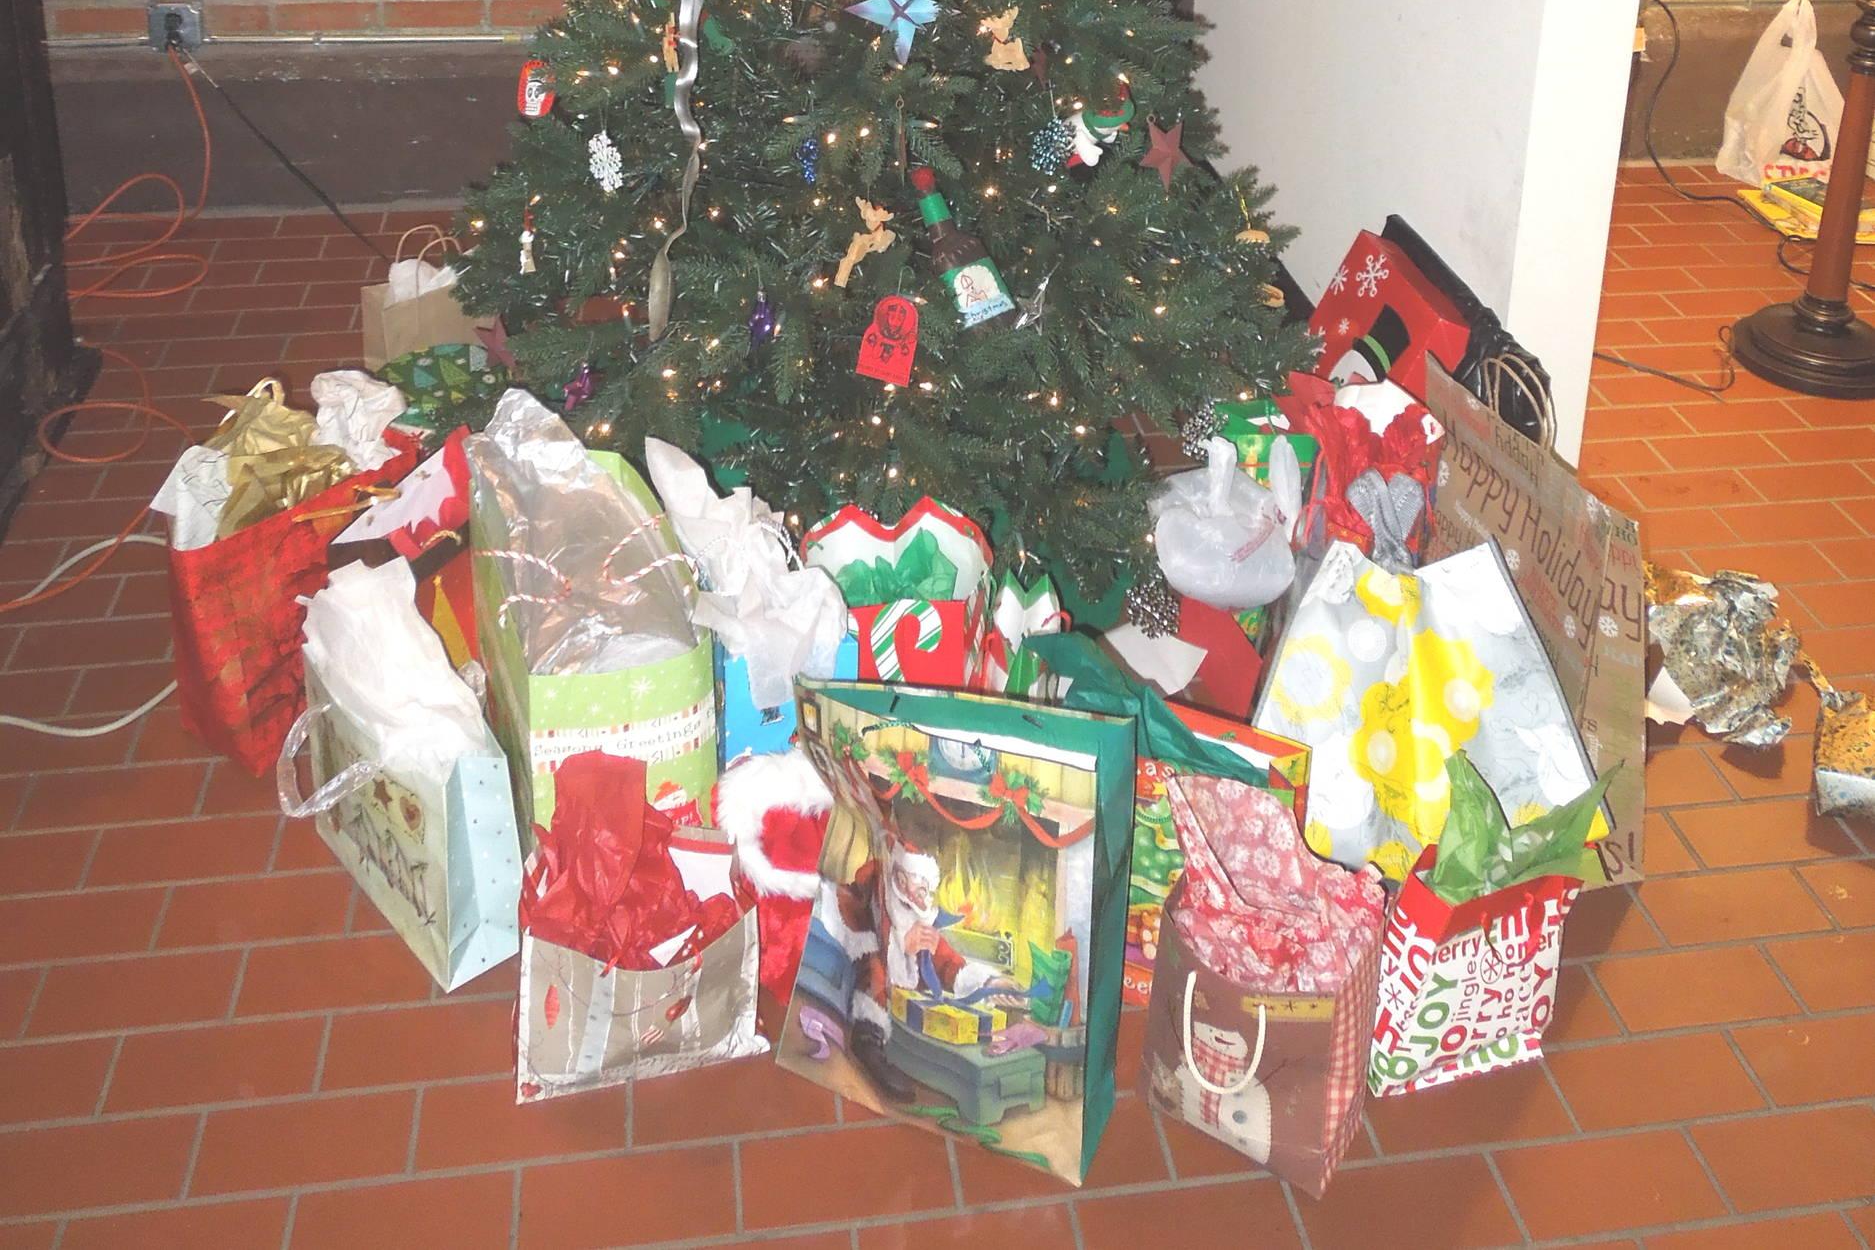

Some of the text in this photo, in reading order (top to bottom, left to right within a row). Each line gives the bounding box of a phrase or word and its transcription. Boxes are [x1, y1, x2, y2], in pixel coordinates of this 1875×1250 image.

[1443, 410, 1520, 535] Happy
[1408, 972, 1459, 1058] JOY
[1450, 960, 1481, 1024] jingle
